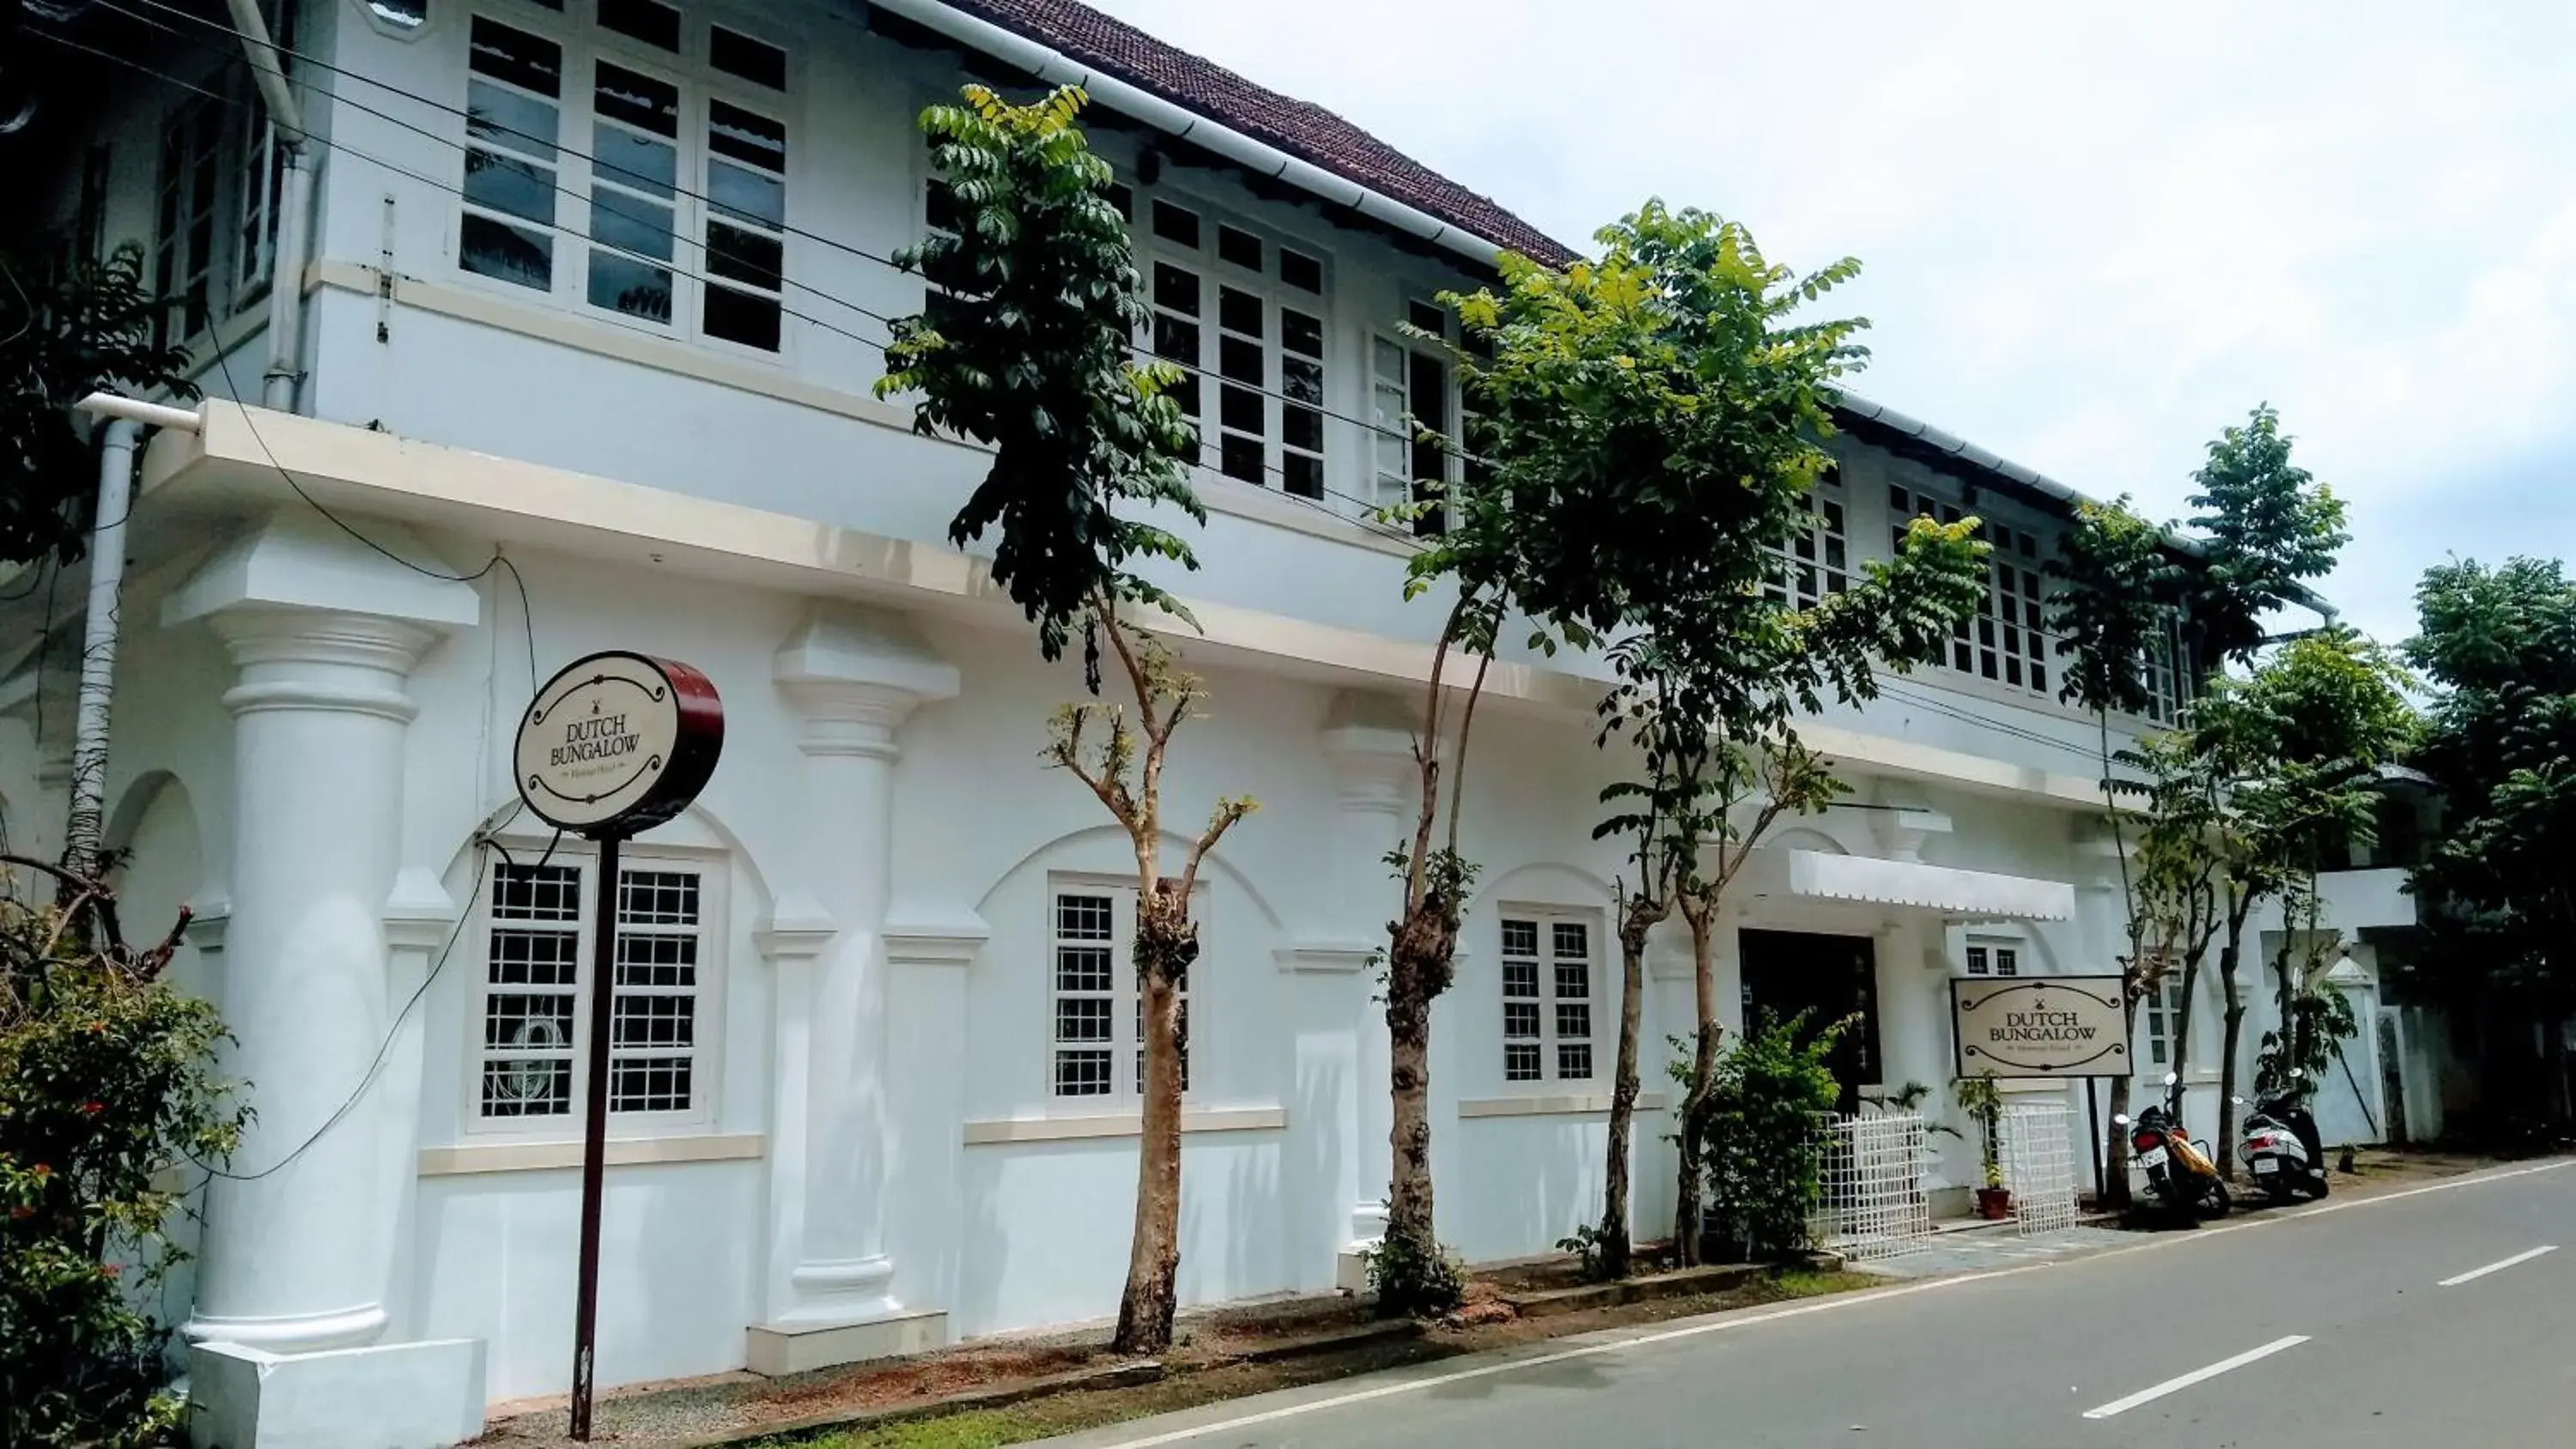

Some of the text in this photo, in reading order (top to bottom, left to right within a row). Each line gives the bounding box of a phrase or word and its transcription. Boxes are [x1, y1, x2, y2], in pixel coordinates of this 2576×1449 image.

[567, 714, 625, 743] DUTCH
[550, 735, 640, 766] BUNGALOW
[2007, 1012, 2077, 1027] DUTCH
[1990, 1028, 2096, 1041] BUNGALOW
